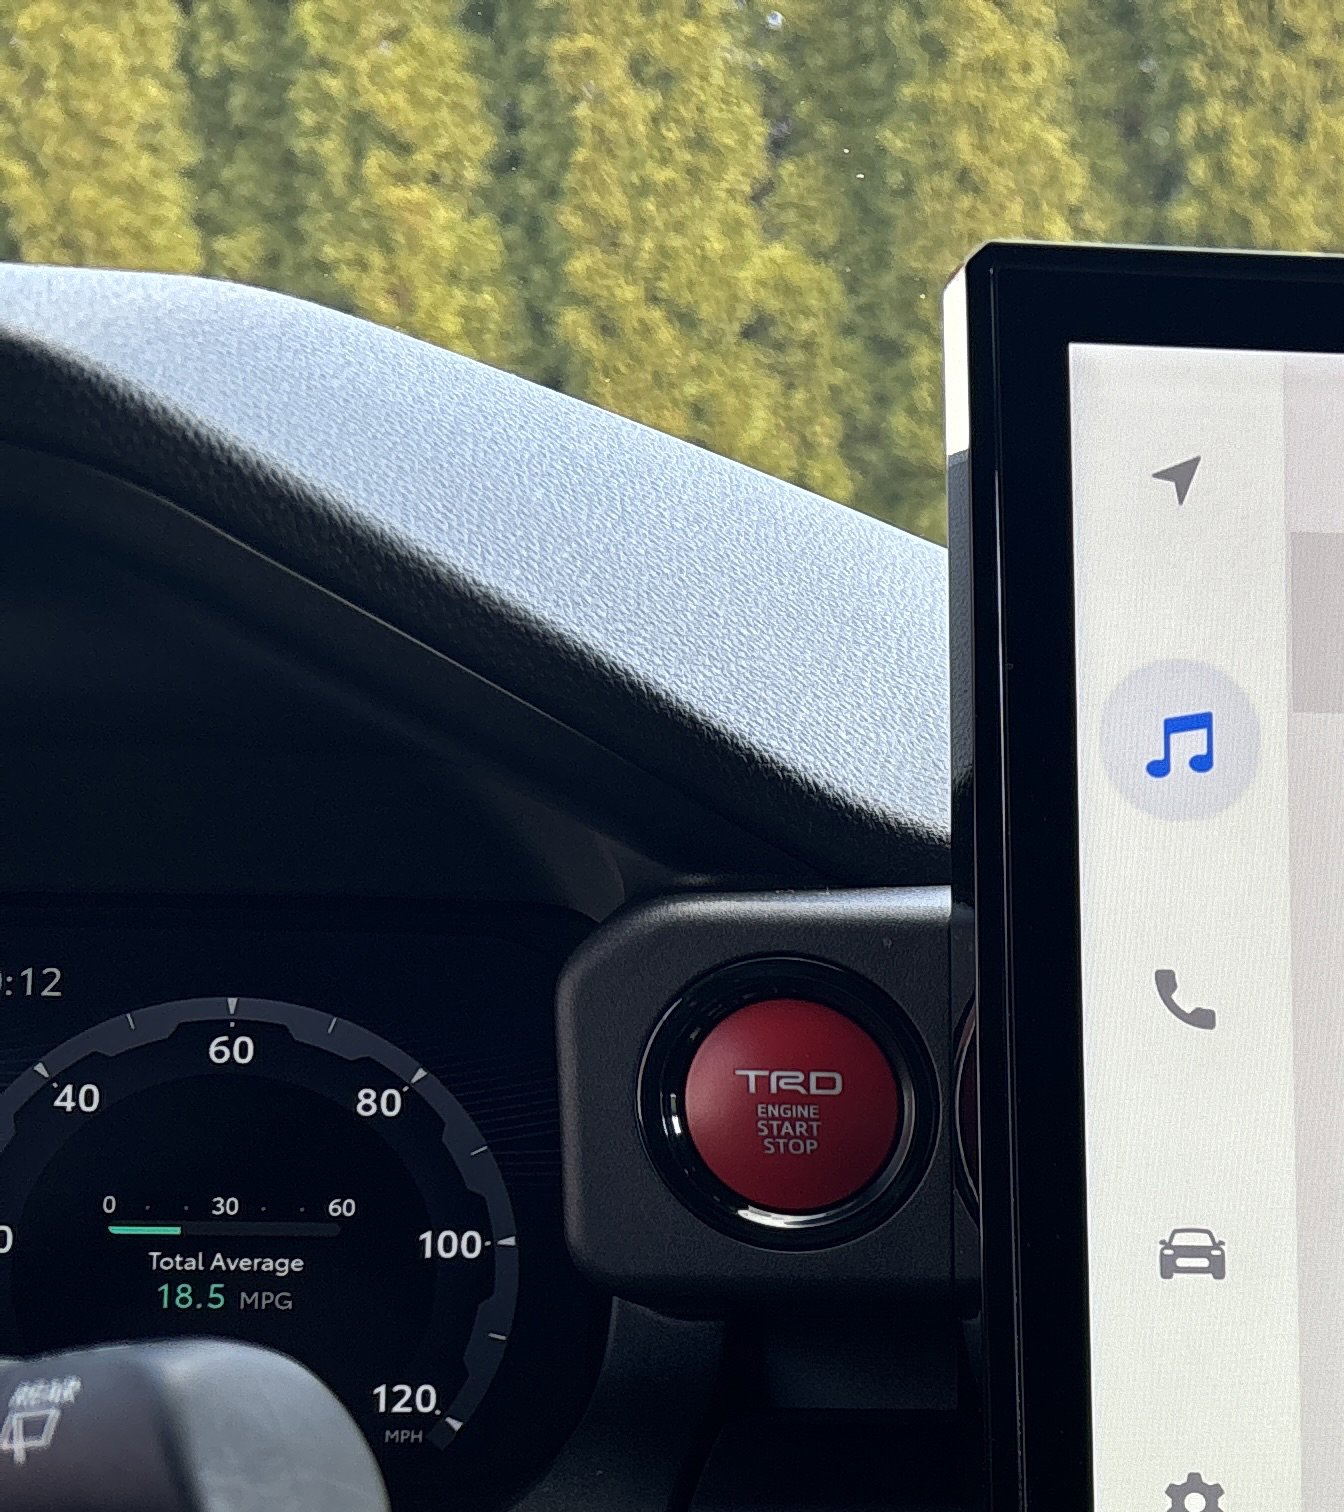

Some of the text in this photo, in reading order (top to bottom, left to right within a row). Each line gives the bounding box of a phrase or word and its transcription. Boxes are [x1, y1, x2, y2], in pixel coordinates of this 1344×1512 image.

[0, 966, 62, 996] :12
[209, 1036, 254, 1064] 60
[734, 1069, 843, 1095] TRD
[53, 1083, 99, 1112] 40
[357, 1089, 401, 1116] 80
[757, 1104, 820, 1119] ENGINE
[757, 1120, 822, 1137] START
[763, 1138, 819, 1154] STOP
[103, 1196, 116, 1213] 0
[212, 1197, 238, 1215] 30
[329, 1199, 355, 1216] 60
[419, 1230, 481, 1258] 100
[149, 1252, 304, 1276] Total Average
[158, 1284, 292, 1310] 18.5 MPG
[373, 1384, 436, 1412] 120
[385, 1430, 422, 1442] MPH
